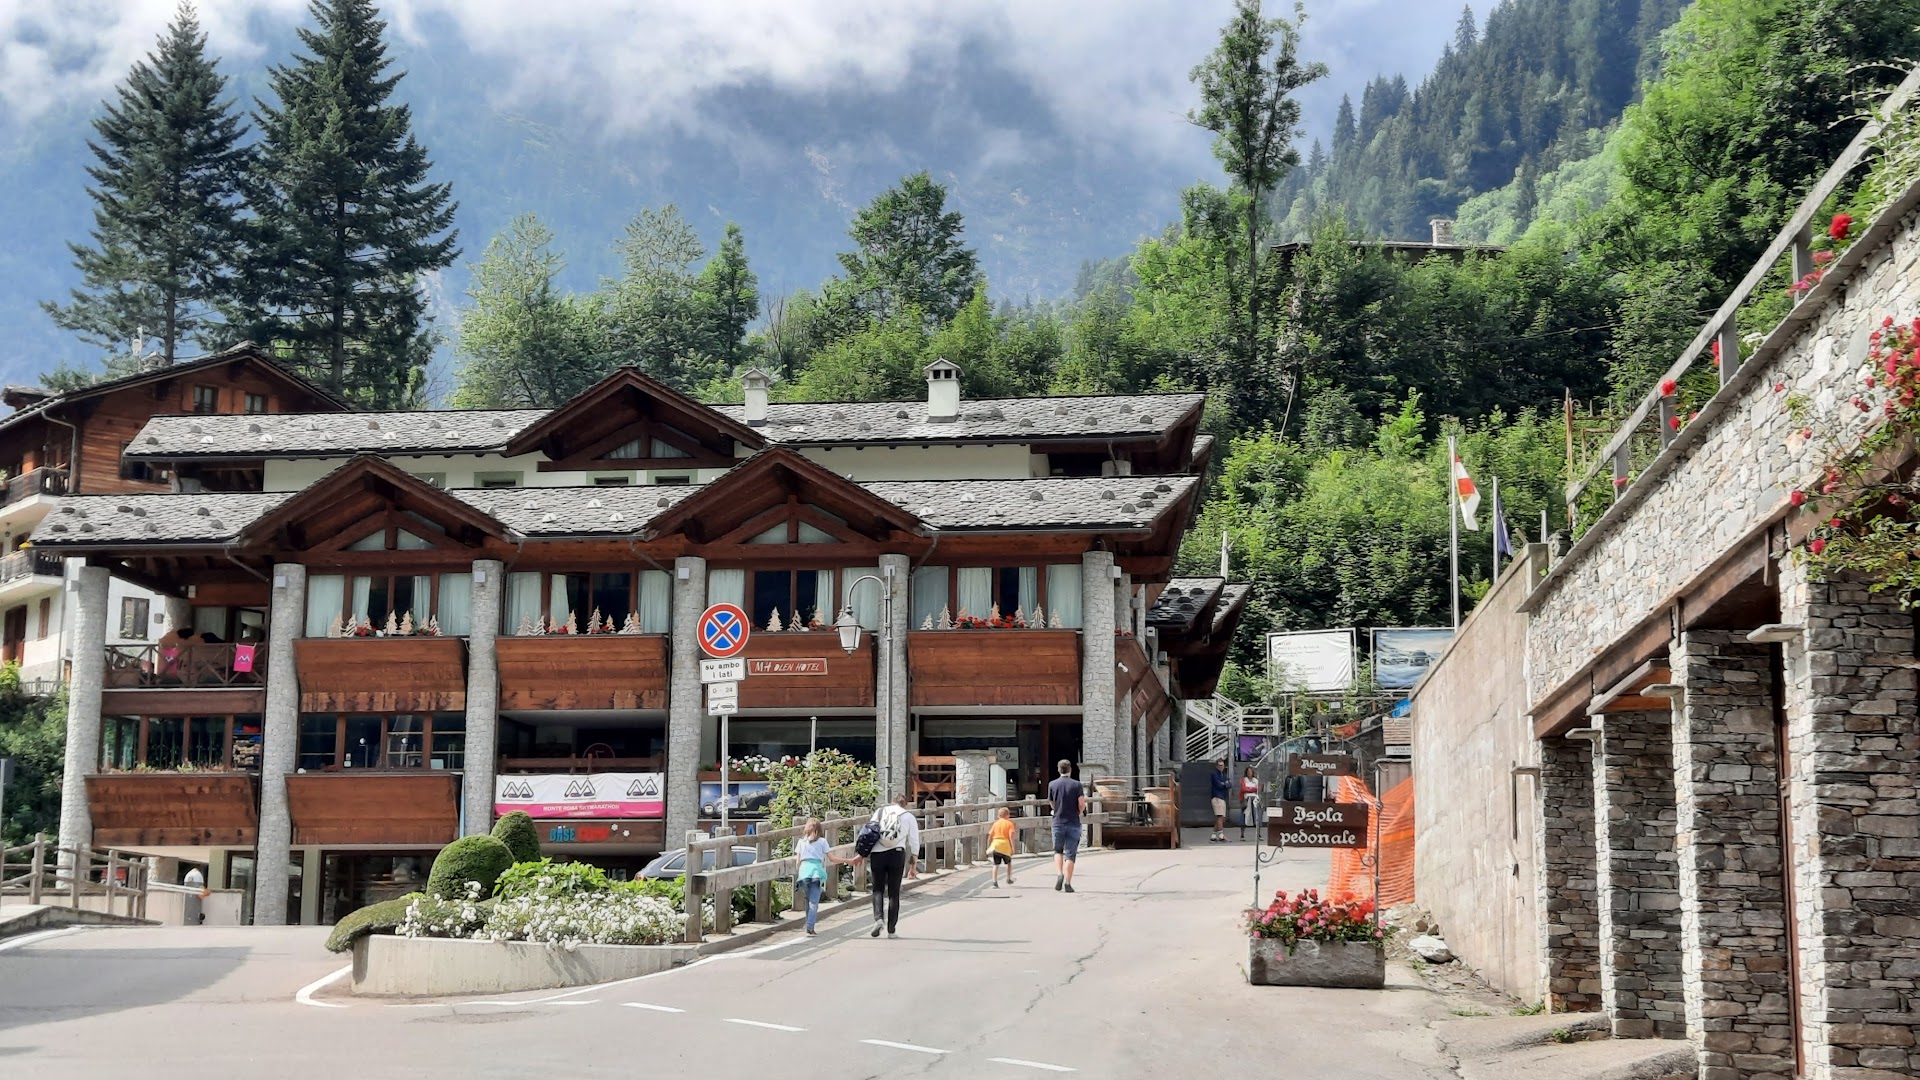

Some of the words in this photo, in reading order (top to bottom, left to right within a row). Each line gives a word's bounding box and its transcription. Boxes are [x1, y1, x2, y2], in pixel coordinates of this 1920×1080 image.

[719, 670, 733, 678] lati
[774, 663, 794, 672] OLEN
[795, 663, 820, 672] HOTEL
[1301, 759, 1336, 770] Alagna
[1293, 806, 1344, 824] Isola
[549, 826, 575, 842] BASE
[1280, 829, 1356, 846] pedonale
